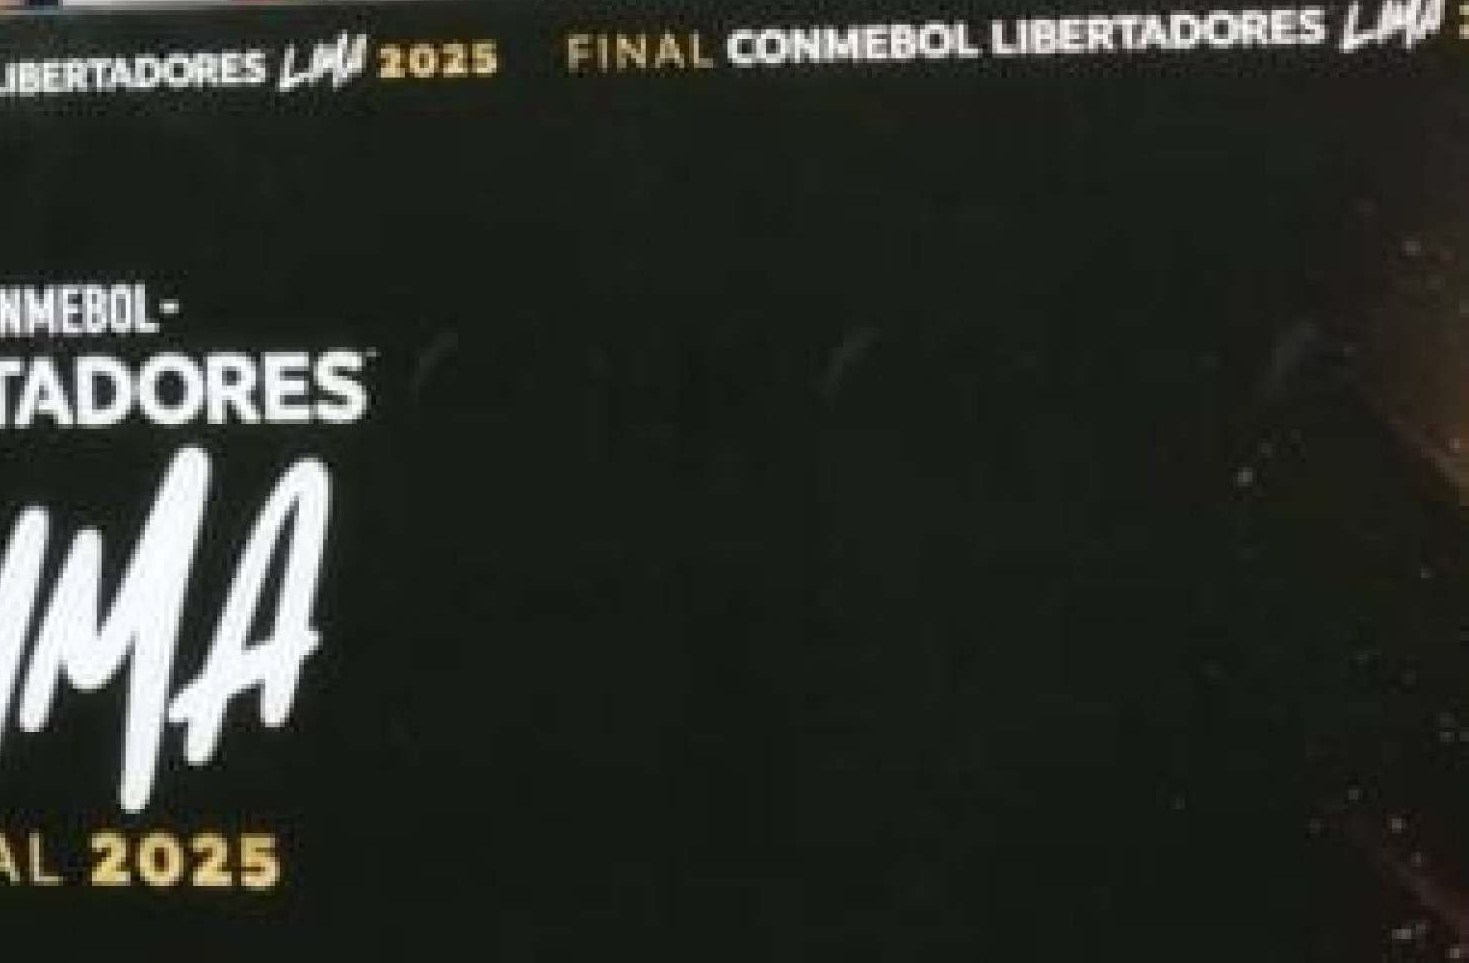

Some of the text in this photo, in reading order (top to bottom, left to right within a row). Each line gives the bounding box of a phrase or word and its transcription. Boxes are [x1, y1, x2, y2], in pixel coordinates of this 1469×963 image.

[377, 40, 498, 80] 2025
[565, 29, 715, 72] FINAL
[727, 20, 979, 68] CONMEBOL
[990, 5, 1327, 57] LIBERTADORES
[90, 831, 281, 891] 2025
